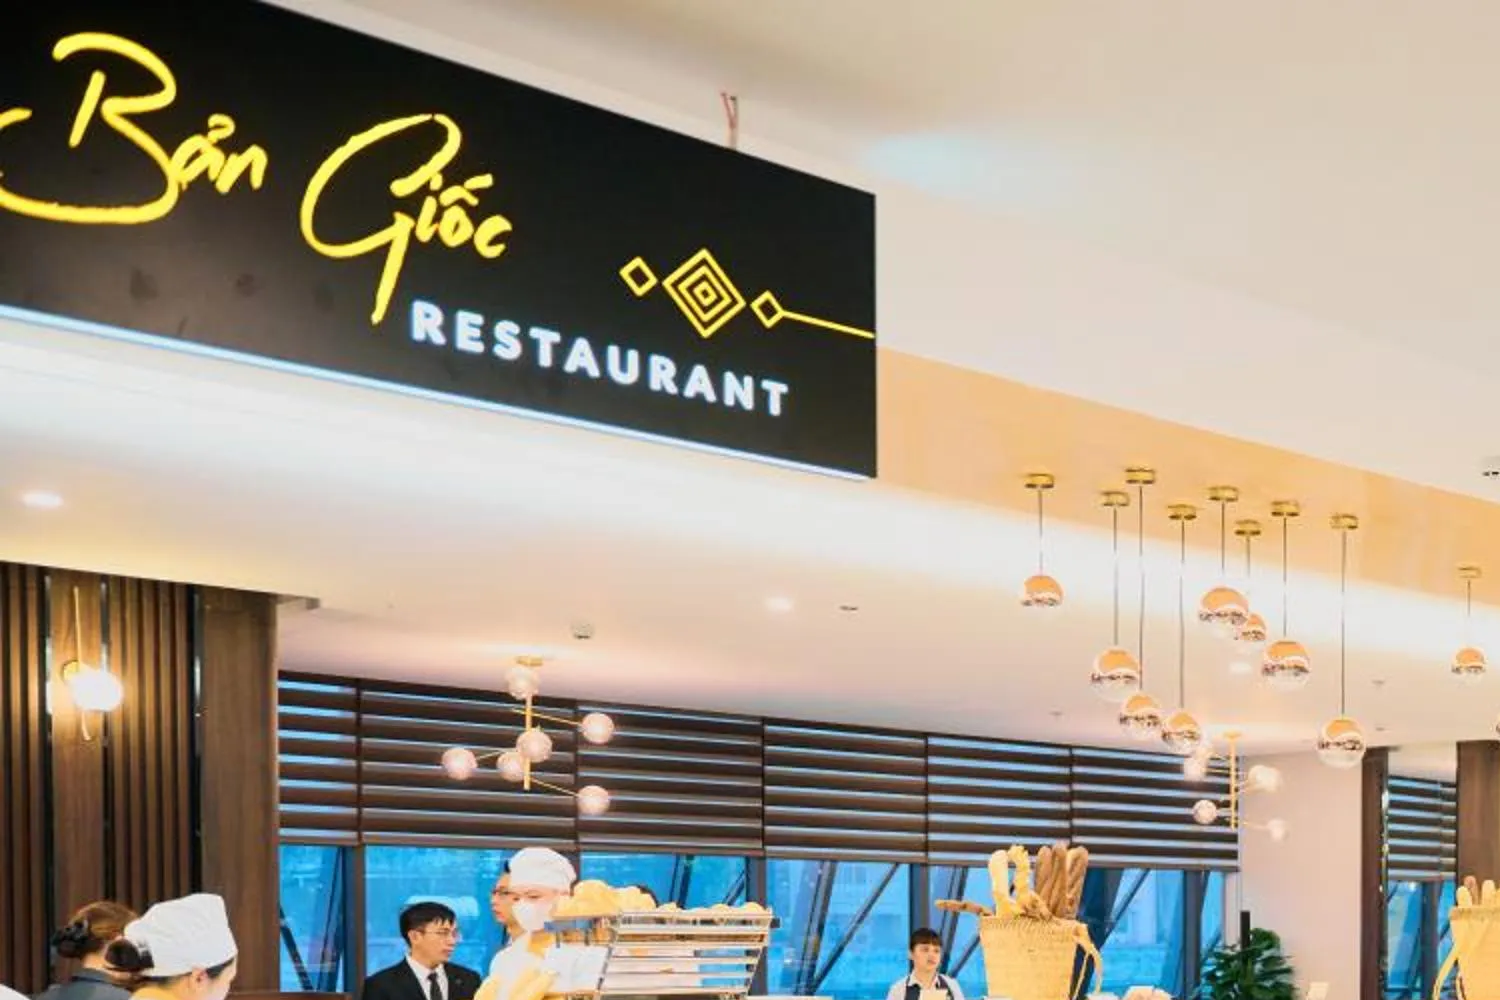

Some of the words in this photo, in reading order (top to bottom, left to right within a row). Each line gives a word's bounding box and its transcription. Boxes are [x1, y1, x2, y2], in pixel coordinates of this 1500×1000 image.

[0, 32, 268, 225] Bản
[301, 113, 512, 326] Giốc
[410, 299, 790, 417] RESTAURANT
